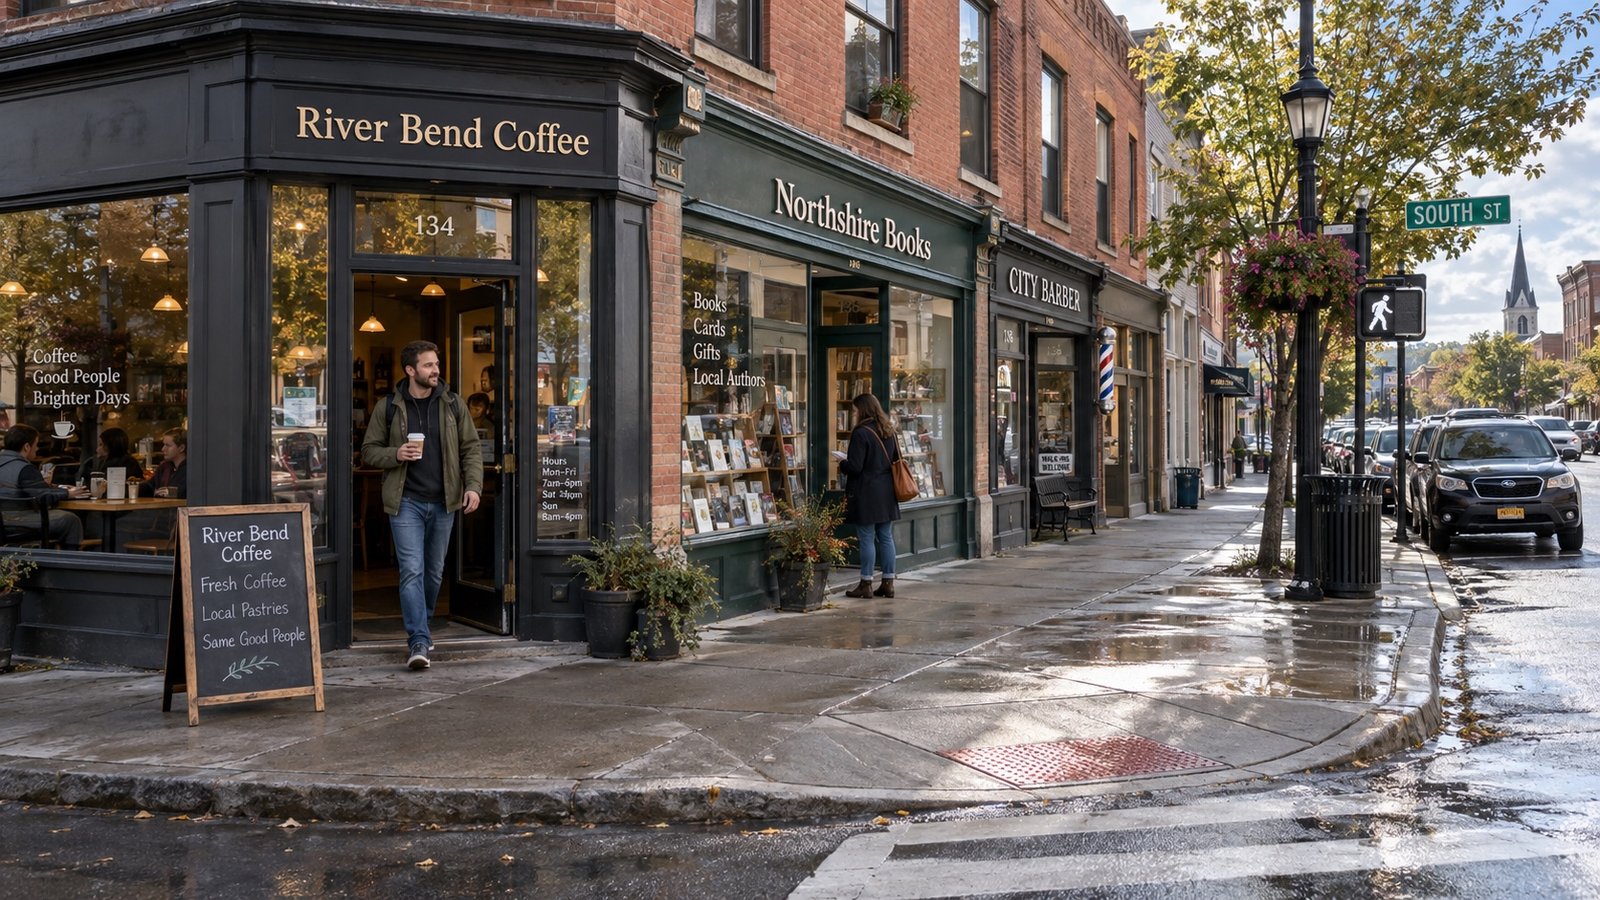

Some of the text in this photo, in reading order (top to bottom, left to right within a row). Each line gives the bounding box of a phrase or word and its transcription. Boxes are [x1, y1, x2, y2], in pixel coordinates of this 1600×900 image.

[296, 106, 590, 156] River Bend Coffee
[773, 177, 932, 261] Northshire Books
[1414, 202, 1502, 224] SOUTH ST
[414, 215, 455, 237] 134
[1009, 266, 1081, 312] CITY BARBER
[693, 292, 728, 313] Books
[693, 318, 726, 337] Cards
[33, 347, 78, 364] Coffee
[693, 342, 721, 361] Gifts
[33, 367, 121, 388] Good People
[693, 368, 766, 388] Local Authors
[33, 389, 131, 409] Brighter Days
[542, 456, 568, 466] Hours
[542, 467, 577, 477] Mon-Fri
[542, 490, 556, 499] Sat
[542, 501, 558, 510] Sun
[202, 523, 290, 544] River Bend
[221, 544, 273, 563] Coffee
[201, 572, 288, 594] Fresh Coffee
[202, 602, 289, 622] Local Pastries
[203, 627, 306, 651] Same Good People
